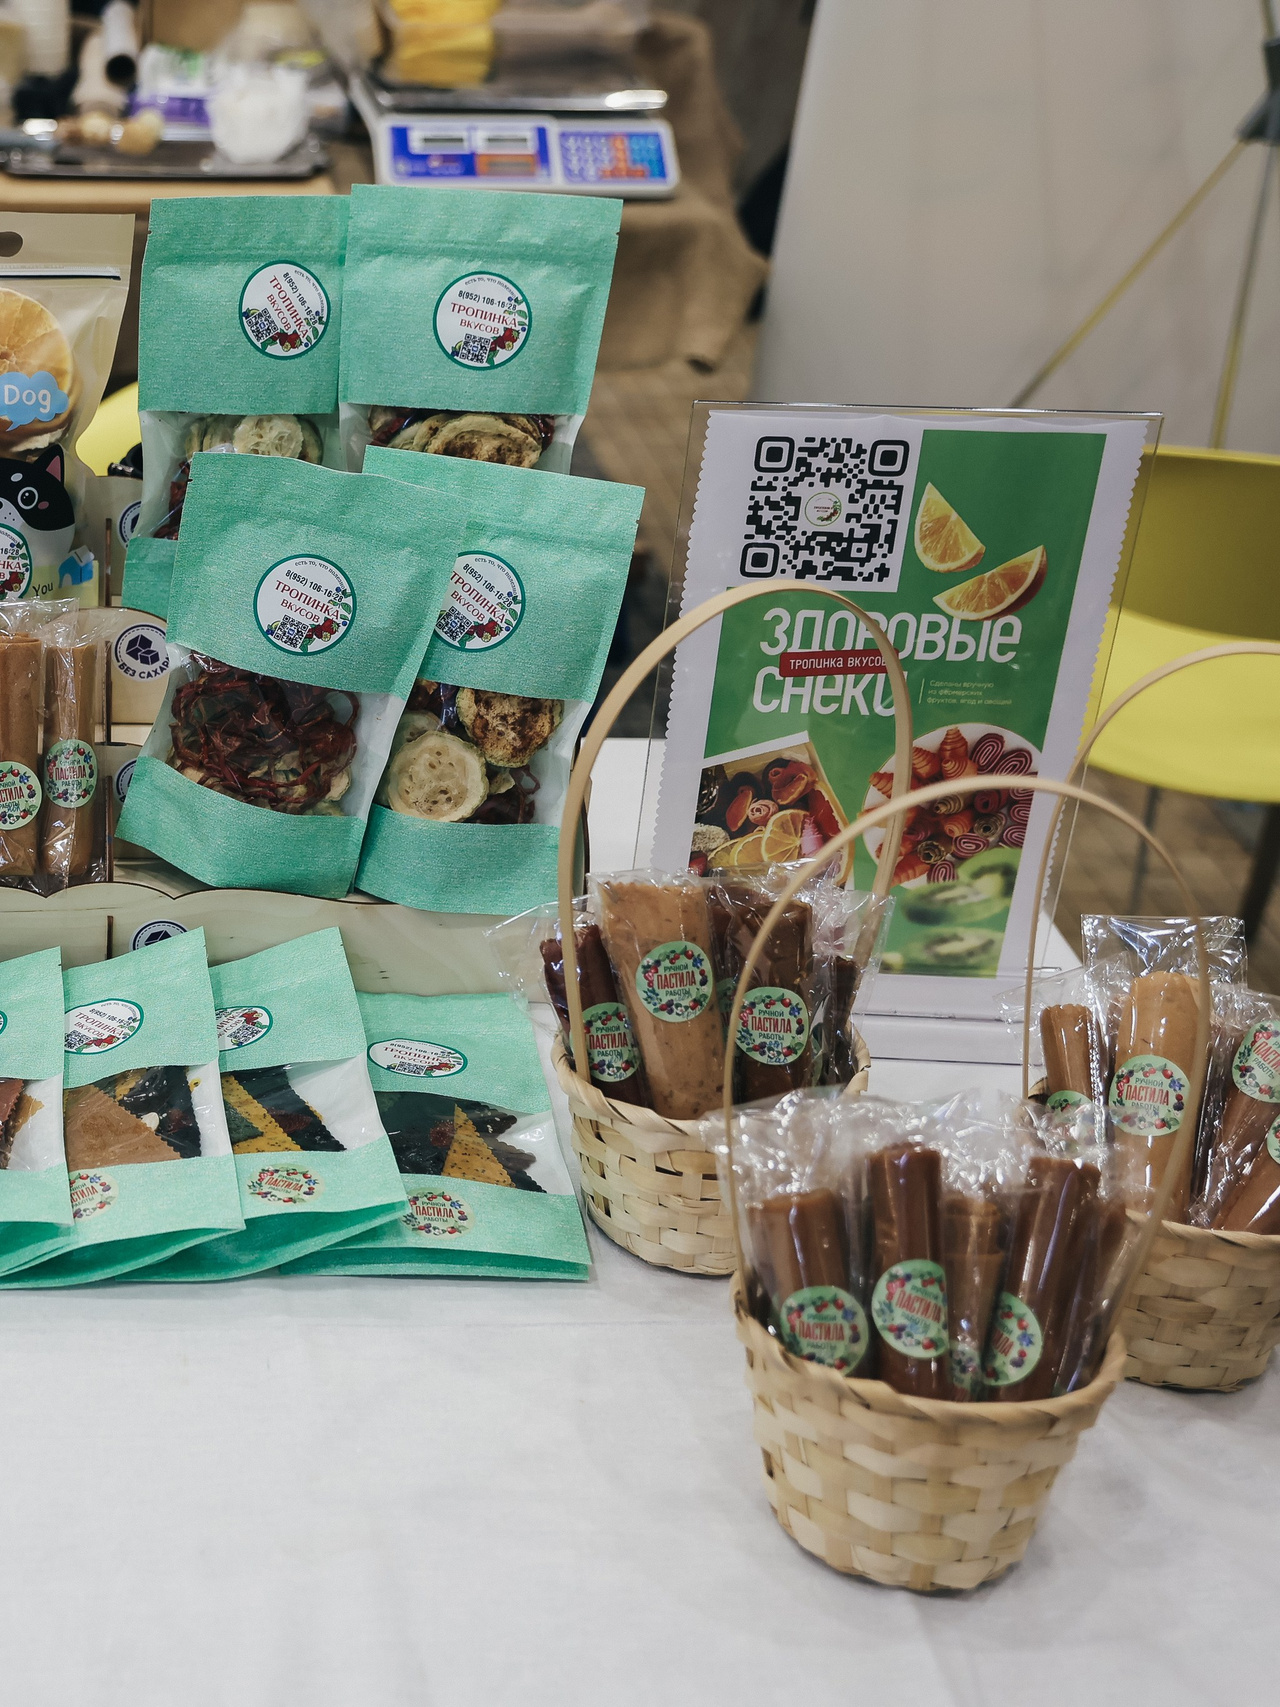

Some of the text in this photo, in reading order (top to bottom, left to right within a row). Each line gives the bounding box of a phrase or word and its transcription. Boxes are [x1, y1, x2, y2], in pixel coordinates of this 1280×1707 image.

[267, 294, 292, 331] ВКУСОВ
[269, 275, 308, 339] ТРОПИНКА
[451, 302, 517, 327] ТРОПИНКА
[460, 318, 500, 335] ВКУСОВ
[3, 384, 52, 413] Dog
[318, 562, 329, 571] что
[463, 563, 484, 584] 8(952)
[488, 559, 496, 567] то,
[497, 563, 506, 573] что
[285, 569, 308, 587] 8(952)
[32, 582, 53, 597] You
[450, 571, 506, 624] ТРОПИНКА
[275, 580, 340, 620] ТРОПИНКА
[450, 590, 486, 622] ВКУСОВ
[280, 599, 321, 623] ВКУСОВ
[118, 662, 136, 677] БЕЗ
[55, 765, 86, 780] ПАСТИЛА
[664, 962, 689, 973] РУЧНОЙ
[657, 970, 696, 990] ПАСТИЛА
[665, 989, 691, 997] РАБОТЫ
[758, 1009, 784, 1017] РУЧНОЙ
[74, 1021, 105, 1037] ВКУСОВ
[75, 1012, 124, 1036] ТРОПИНКА
[596, 1024, 620, 1033] РУЧНОЙ
[751, 1016, 792, 1033] ПАСТИЛА
[589, 1032, 628, 1050] ПАСТИЛА
[384, 1047, 451, 1063] ТРОПИНКА
[394, 1055, 434, 1065] ВКУСОВ
[1135, 1078, 1164, 1087] РУЧНОЙ
[1125, 1084, 1169, 1106] ПАСТИЛА
[265, 1177, 303, 1191] ПАСТИЛА
[71, 1185, 98, 1203] СТИЛА
[416, 1205, 454, 1218] ПАСТИЛА
[896, 1290, 941, 1323] ПАСТИЛА
[799, 1320, 845, 1341] ПАСТИЛА
